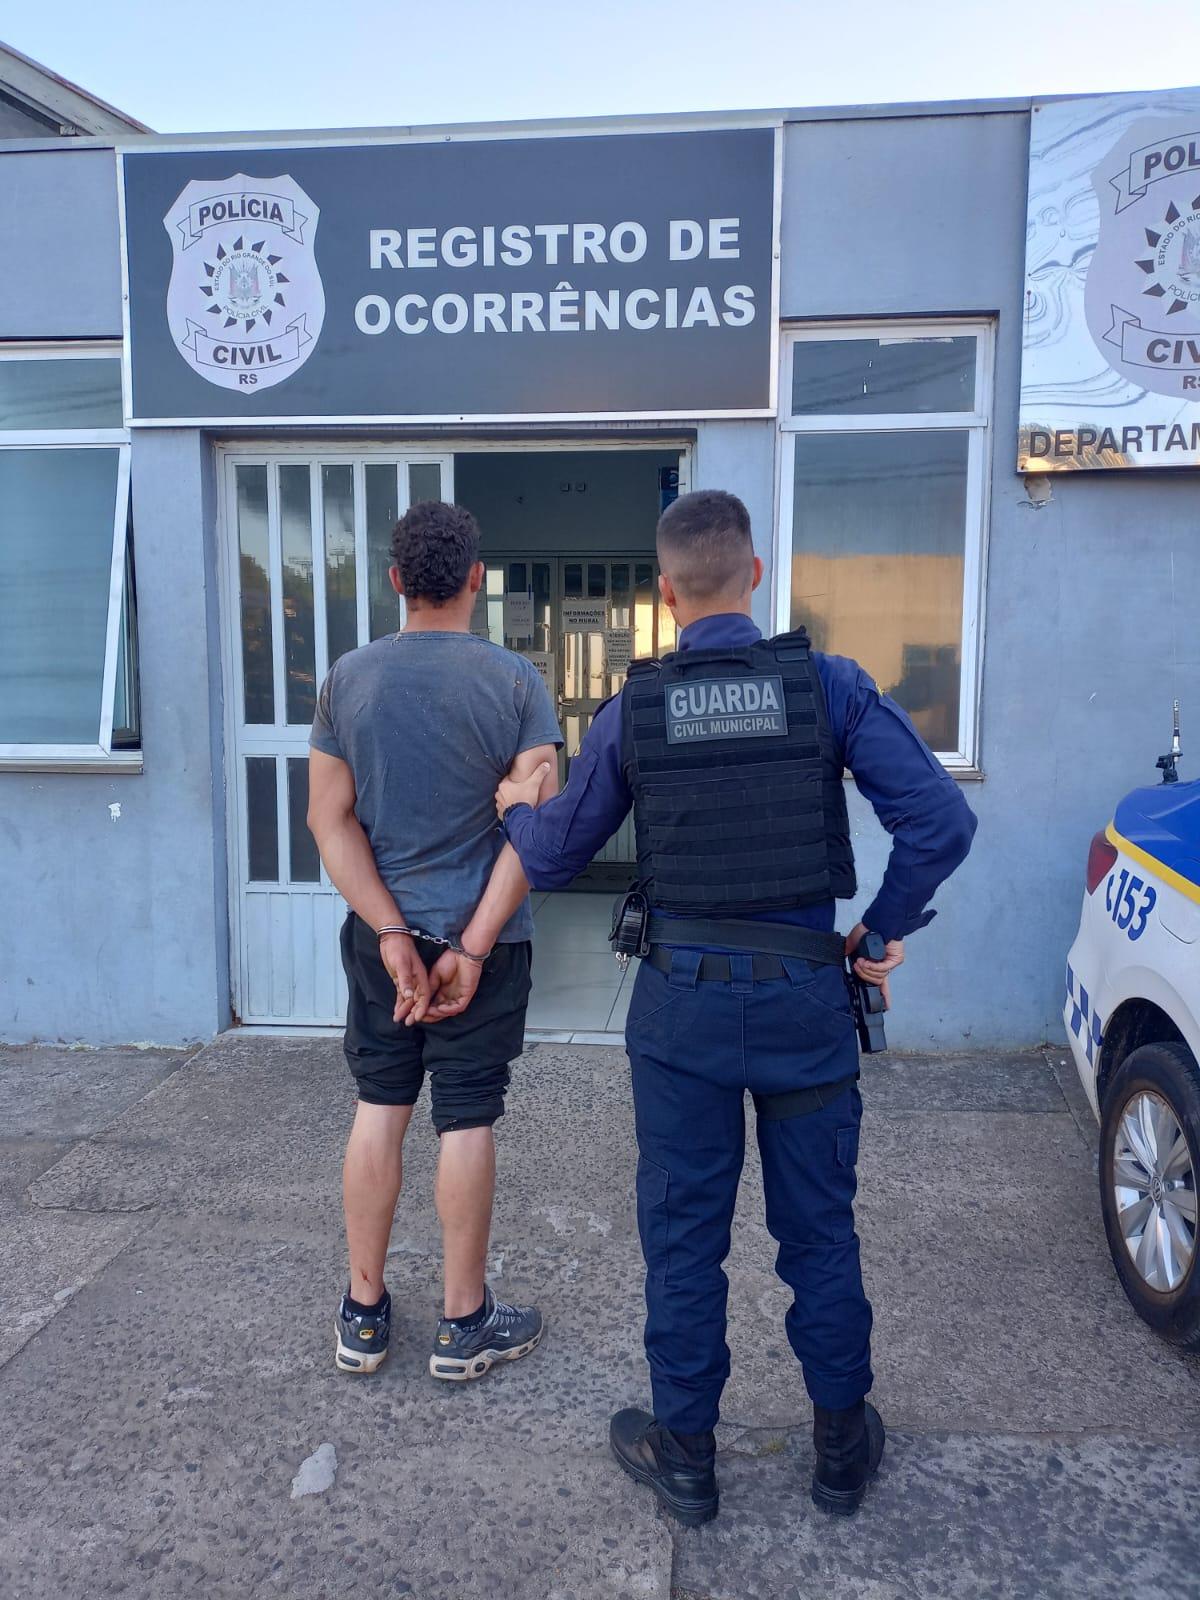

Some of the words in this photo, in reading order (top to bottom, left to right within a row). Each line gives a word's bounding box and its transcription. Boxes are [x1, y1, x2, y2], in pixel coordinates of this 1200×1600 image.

[198, 194, 284, 226] POLÍCIA
[369, 221, 648, 269] REGISTRO
[669, 217, 741, 261] DE
[1158, 232, 1174, 266] ESTADO
[1173, 220, 1186, 232] DO
[222, 257, 231, 267] DO
[242, 252, 266, 267] GRANDE
[354, 281, 756, 335] OCORRÊNCIAS
[213, 343, 282, 366] CIVIL
[238, 373, 258, 385] RS
[563, 609, 605, 617] INFORMAÇÕES
[670, 681, 780, 718] GUARDA
[674, 722, 708, 738] CIVIL
[710, 716, 780, 734] MUNICIPAL
[1111, 868, 1157, 942] 153
